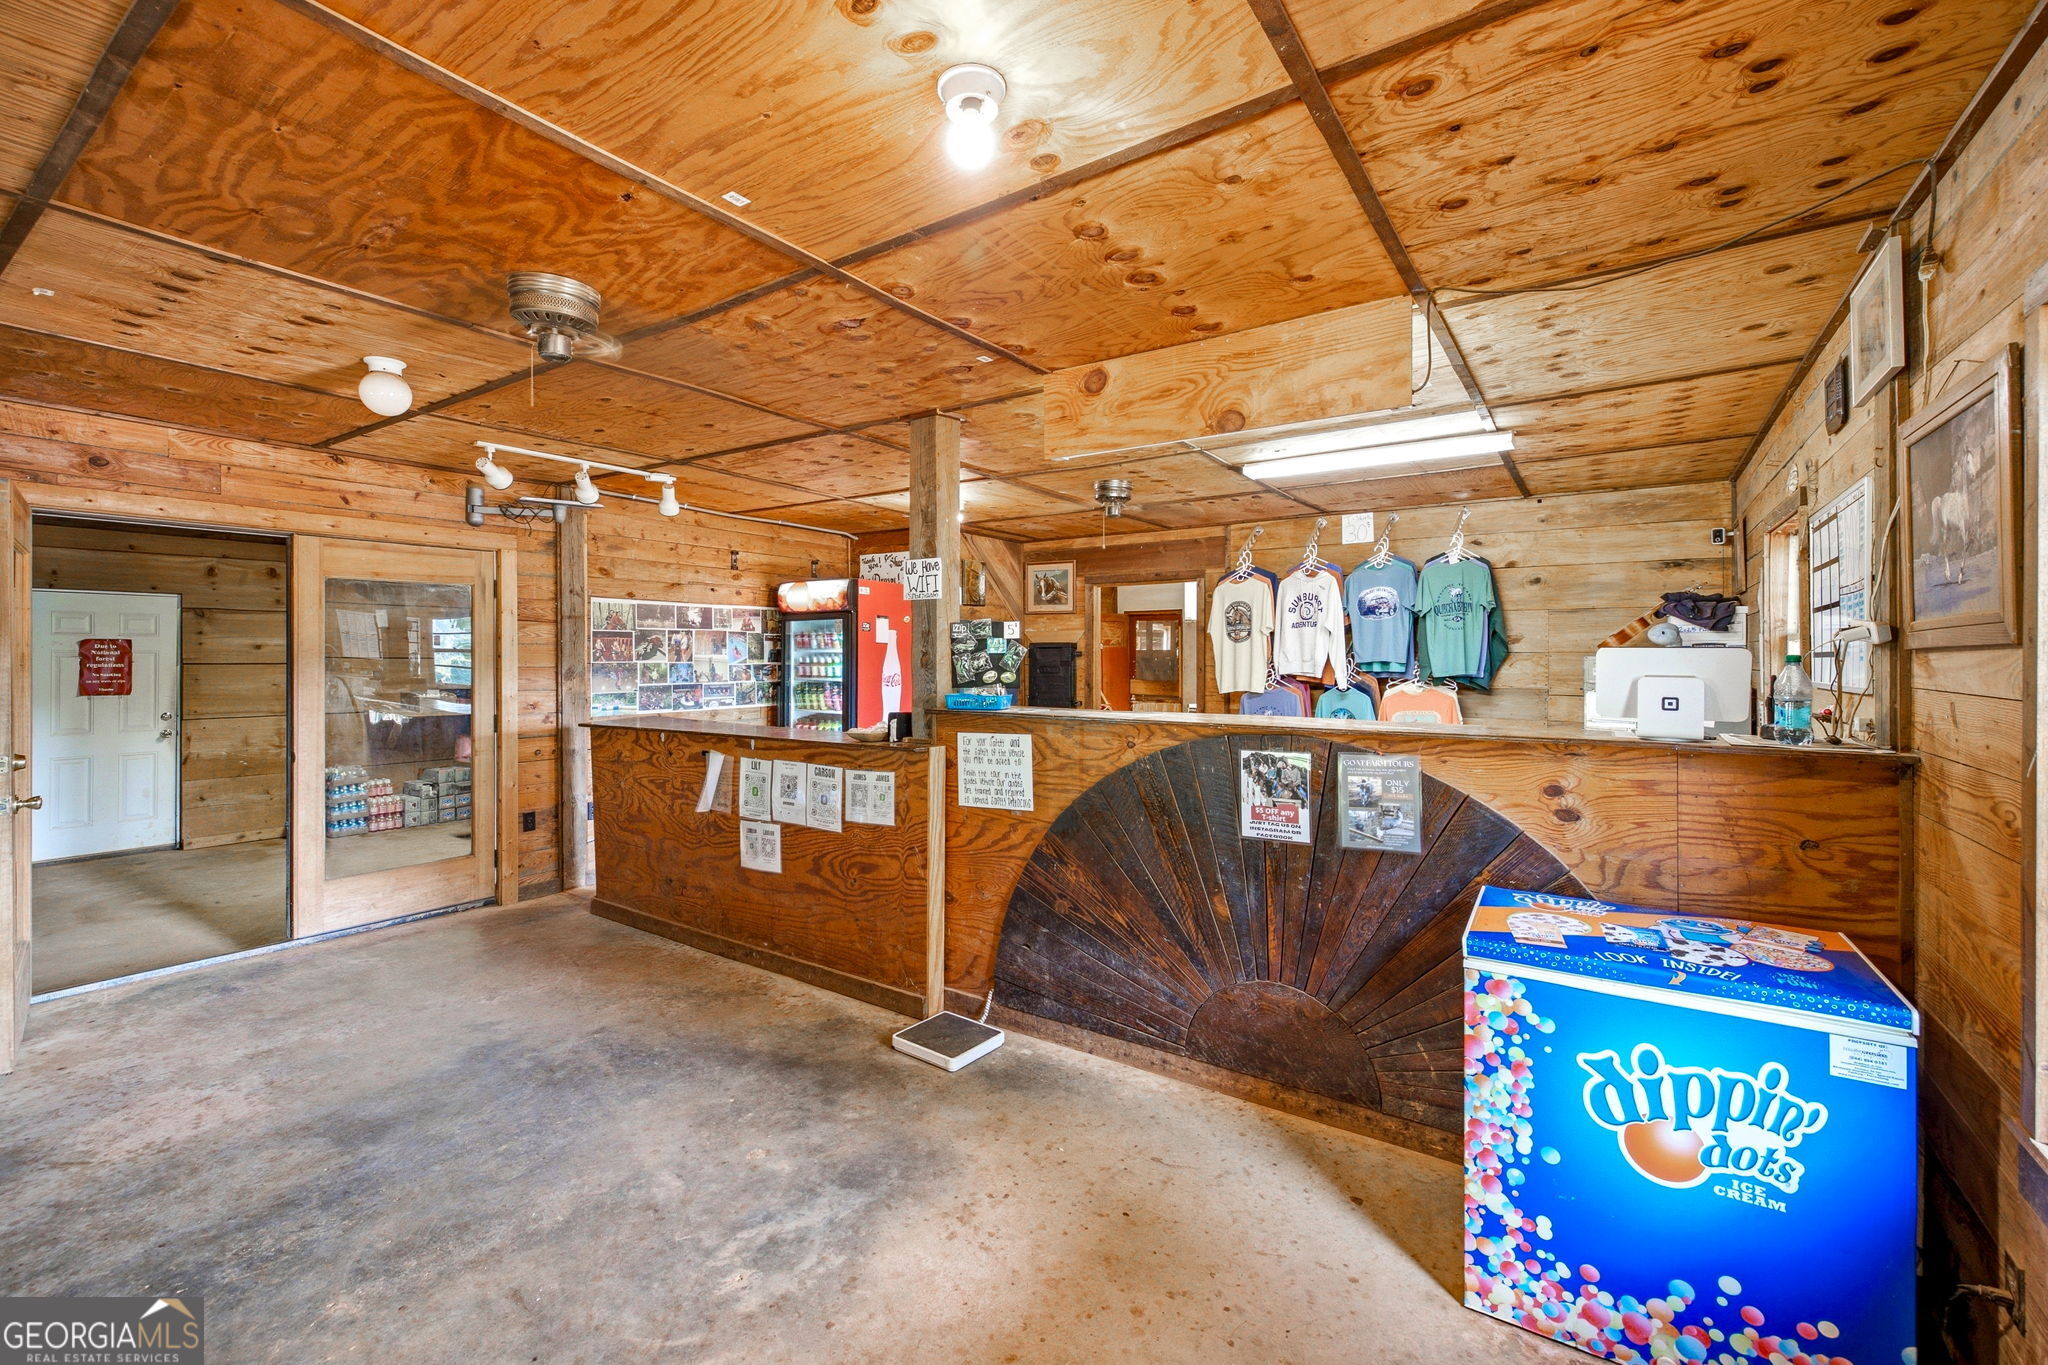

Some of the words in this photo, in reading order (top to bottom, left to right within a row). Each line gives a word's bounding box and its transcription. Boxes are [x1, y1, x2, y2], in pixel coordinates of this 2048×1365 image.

[905, 561, 918, 575] We
[922, 560, 940, 574] Have
[907, 574, 939, 592] WIFI
[1288, 592, 1324, 614] SUNBURST
[751, 760, 761, 770] LILY
[814, 766, 836, 779] CARSON
[1594, 951, 1648, 964] LOOK
[1662, 958, 1742, 981] INSIDE!
[1848, 1038, 1877, 1048] PROPERTY
[1580, 1045, 1825, 1145] dippin'
[1700, 1134, 1798, 1185] dots
[1732, 1180, 1766, 1197] ICE
[1714, 1186, 1787, 1213] CREAM
